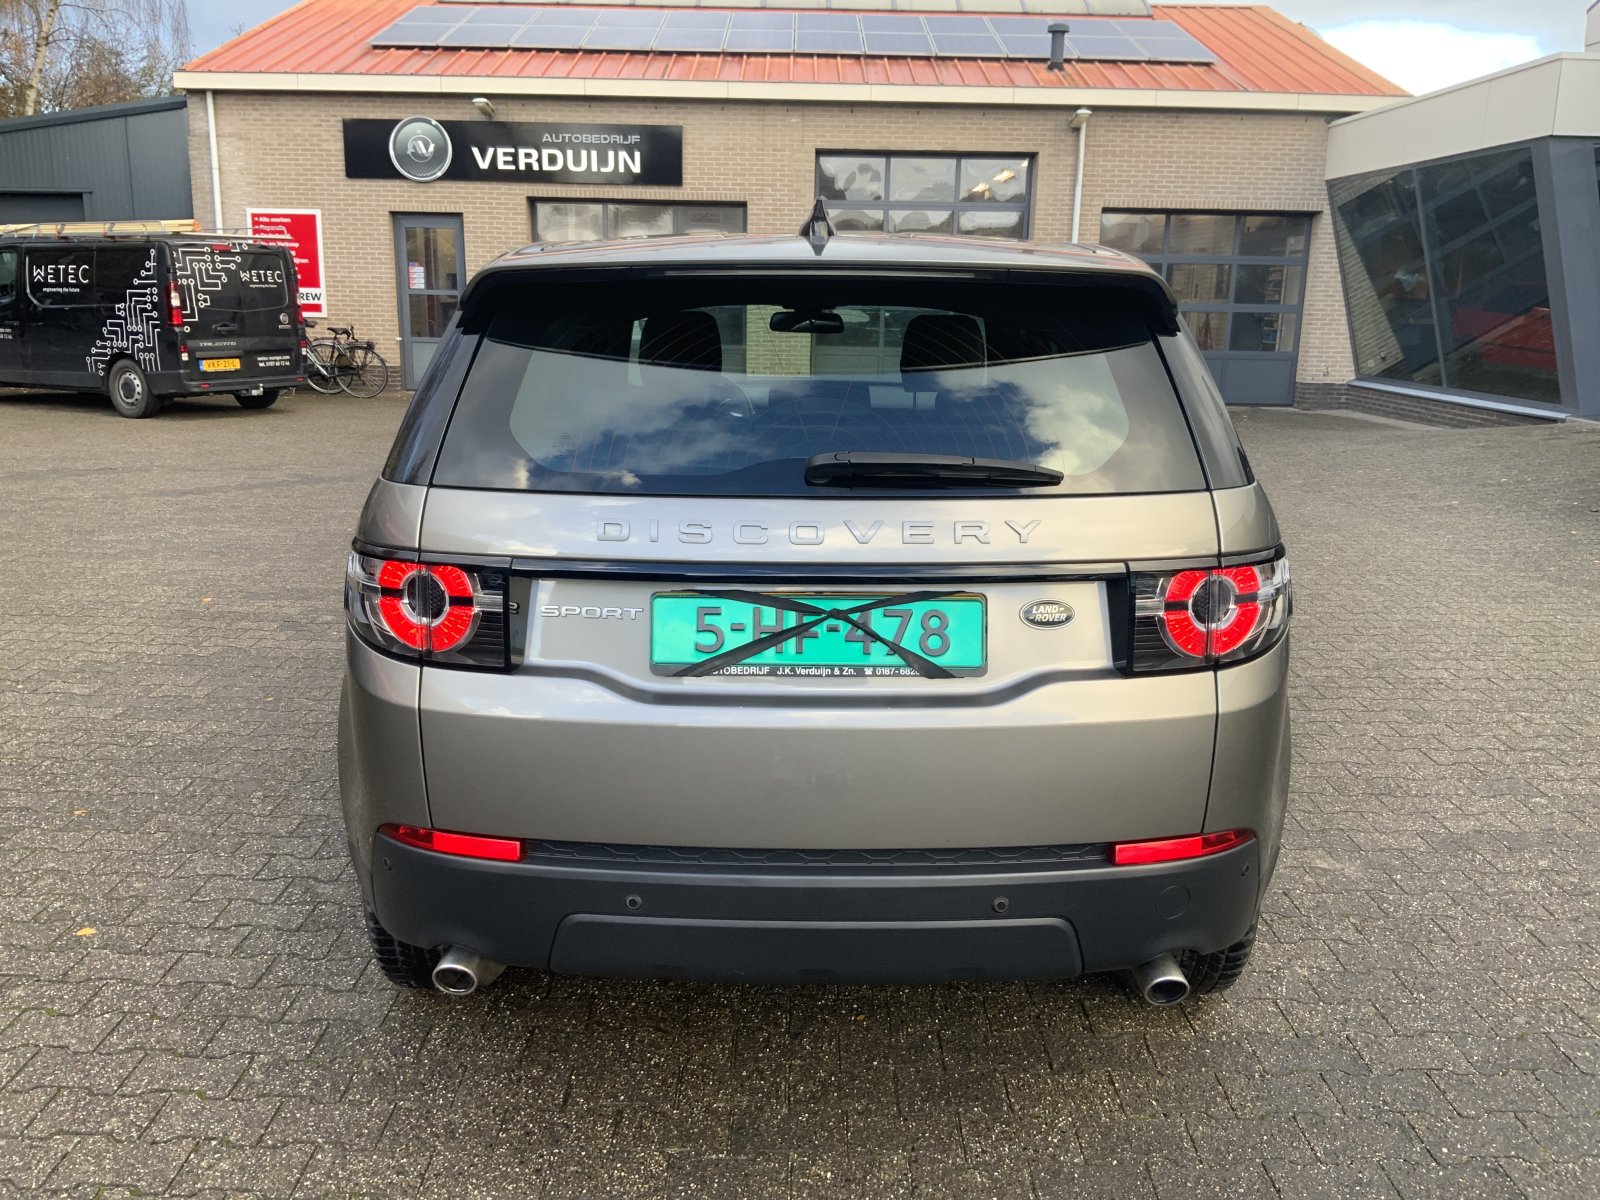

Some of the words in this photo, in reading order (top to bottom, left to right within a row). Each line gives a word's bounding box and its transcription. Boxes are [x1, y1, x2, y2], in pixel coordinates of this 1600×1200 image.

[542, 131, 641, 145] AUTOBEDRIJF
[471, 147, 642, 173] VERDUIJN
[33, 265, 89, 283] WETEC
[240, 270, 283, 283] WETEC
[595, 518, 1043, 545] DISCOVERY
[540, 604, 644, 621] SPORT
[695, 606, 951, 657] 5-HF-478
[712, 666, 770, 675] OBEDRIJF
[777, 667, 794, 675] J.K.
[795, 667, 831, 677] Verduijn
[833, 667, 841, 675] &
[842, 667, 857, 675] Zn.
